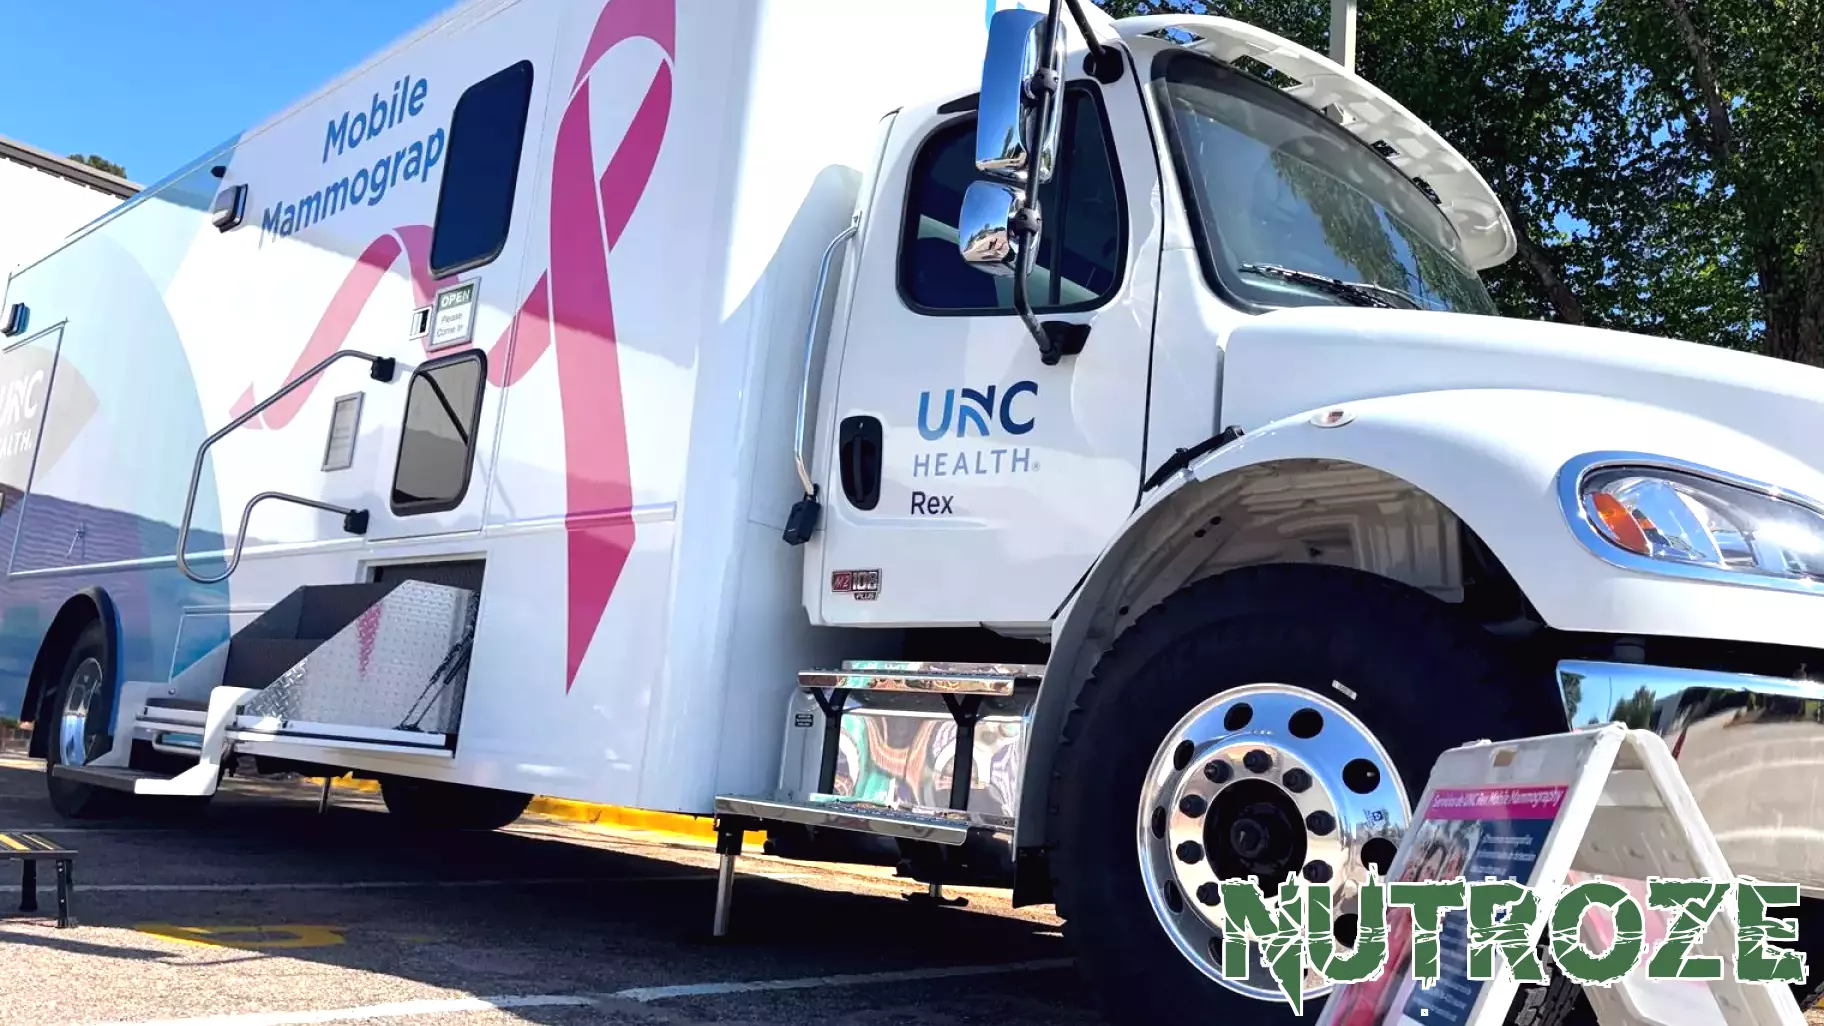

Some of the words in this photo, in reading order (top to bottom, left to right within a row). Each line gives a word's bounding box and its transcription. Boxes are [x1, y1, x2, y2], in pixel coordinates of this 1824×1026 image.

[322, 75, 428, 164] Mobile
[258, 127, 446, 250] Mammograp
[441, 289, 471, 307] OPEN
[441, 312, 463, 323] Please
[917, 380, 1039, 441] UNC
[910, 490, 954, 515] Rex
